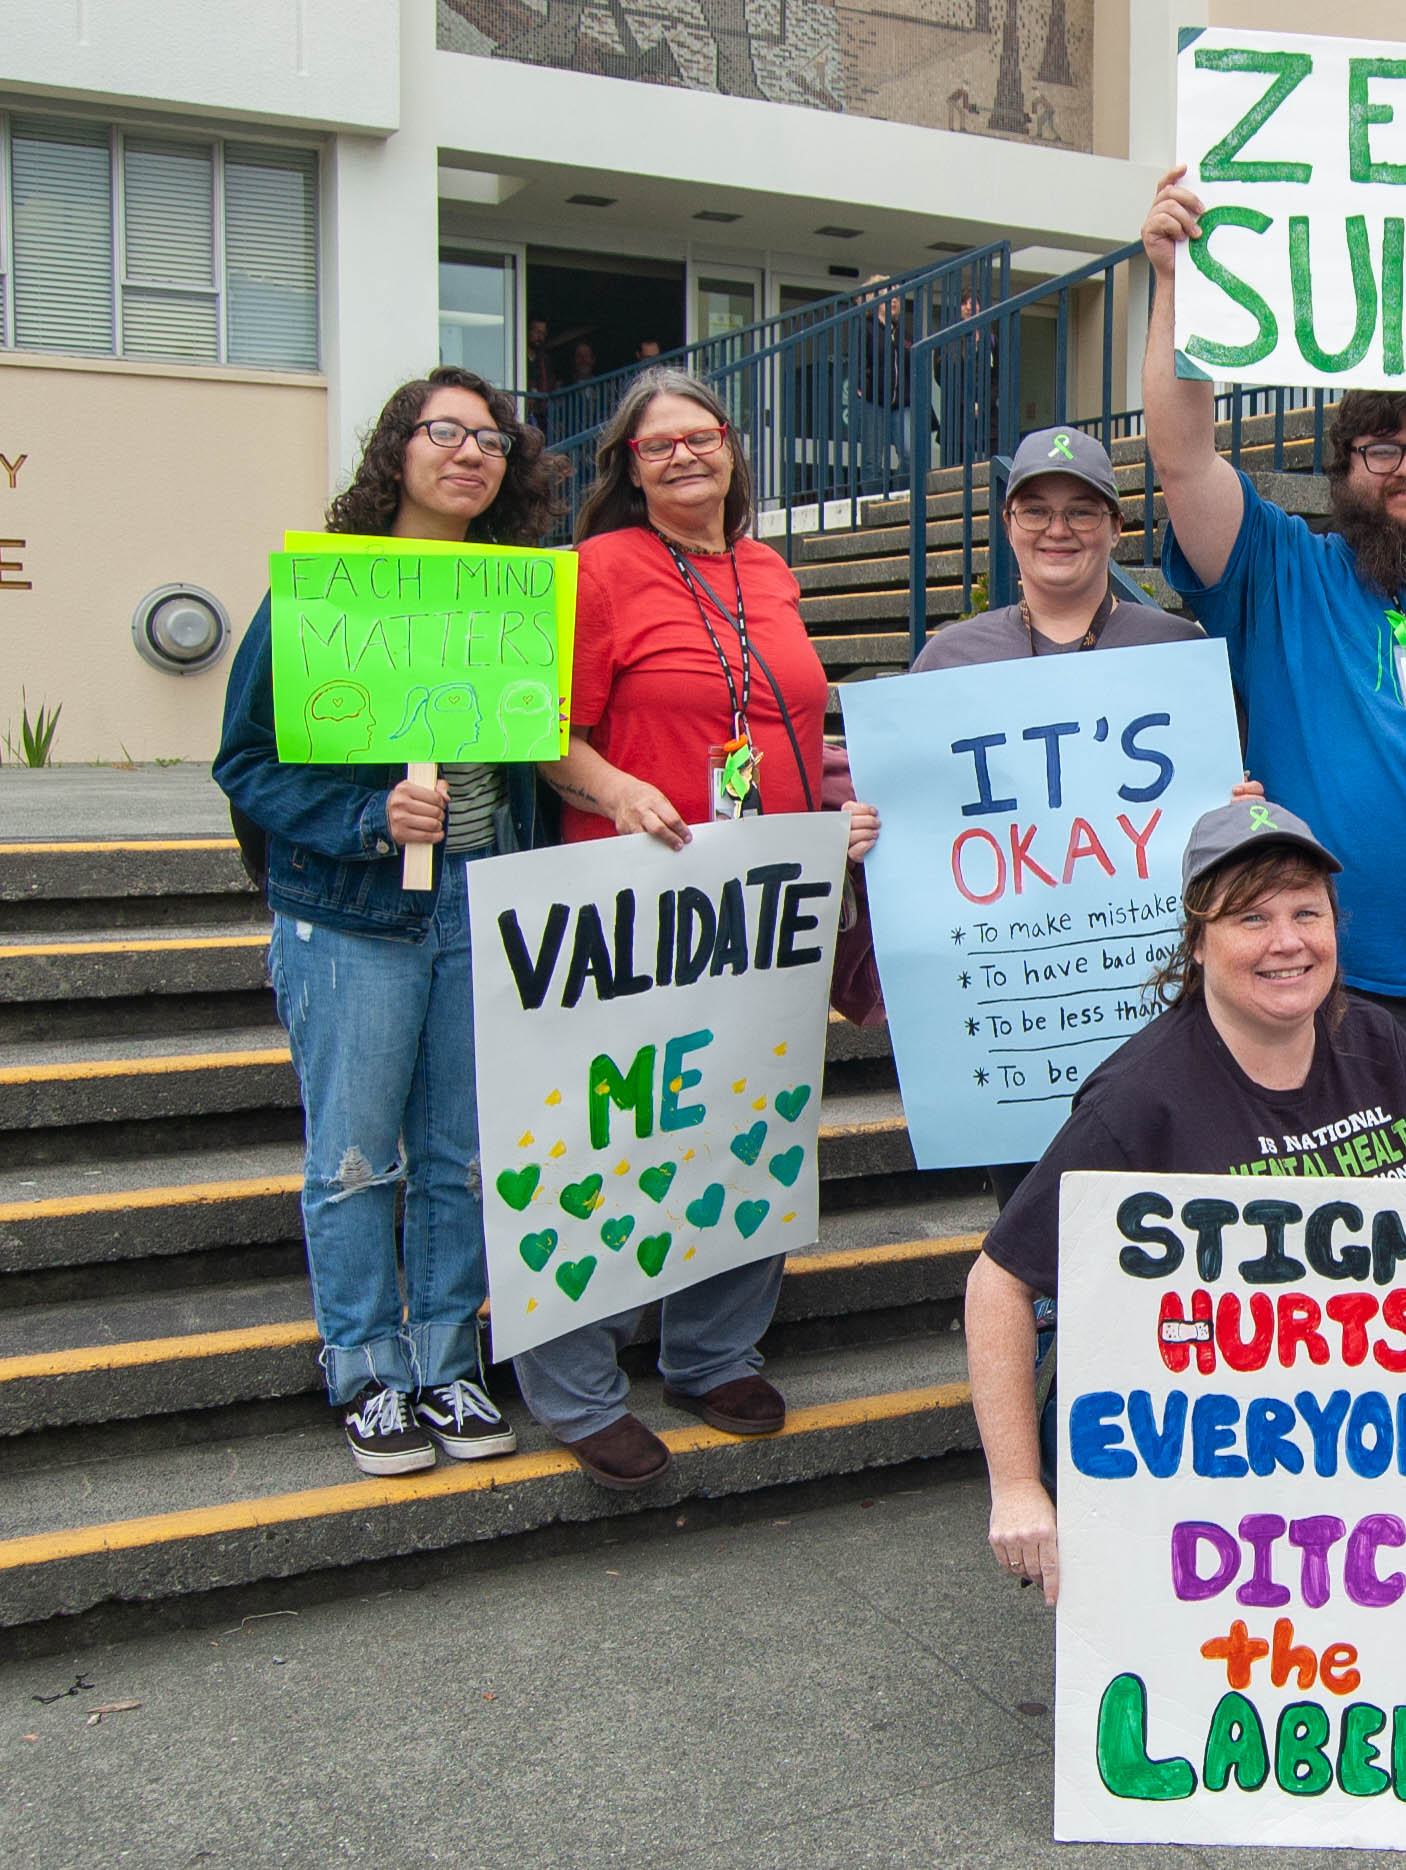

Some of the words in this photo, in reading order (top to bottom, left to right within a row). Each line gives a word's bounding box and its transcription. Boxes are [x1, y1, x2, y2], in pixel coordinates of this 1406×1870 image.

[291, 558, 422, 600] EACH
[456, 558, 555, 600] MIND
[299, 611, 555, 677] MATTERS
[950, 713, 1175, 816] IT'S
[951, 808, 1164, 904] OKAY
[497, 862, 832, 1010] VALIDATE
[973, 923, 998, 943] To
[1009, 913, 1072, 939] make
[1087, 893, 1183, 929] mistake
[979, 964, 1007, 988] To
[1023, 957, 1088, 985] have
[1102, 946, 1136, 970] bad
[985, 1016, 1012, 1038] To
[1022, 1010, 1046, 1032] be
[1060, 1005, 1104, 1031] less
[588, 1029, 714, 1151] ME
[997, 1065, 1025, 1088] To
[1047, 1059, 1078, 1084] be
[1283, 1106, 1392, 1153] NATIONAL
[1200, 1617, 1361, 1695] the
